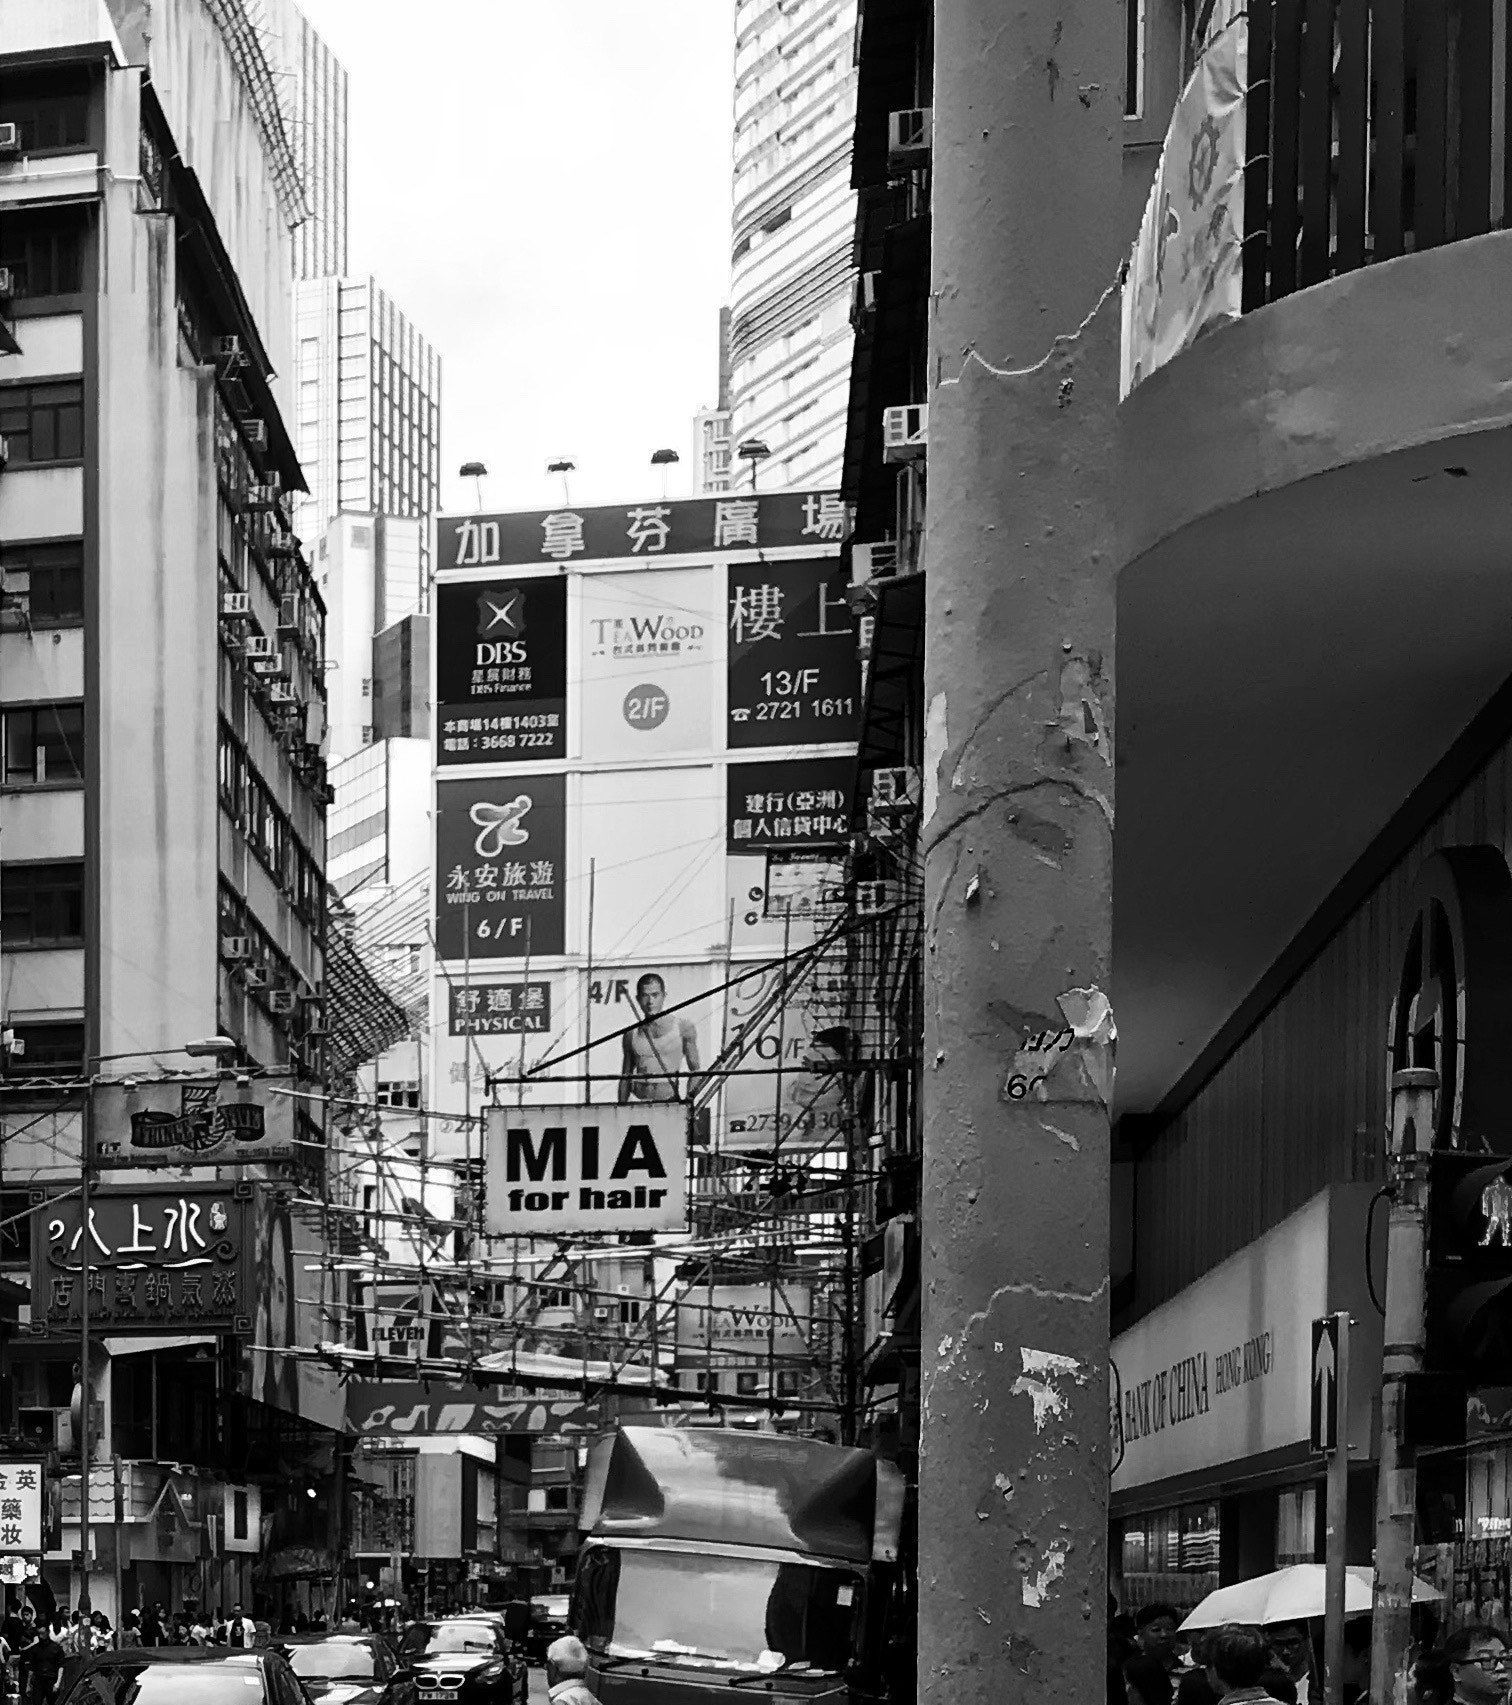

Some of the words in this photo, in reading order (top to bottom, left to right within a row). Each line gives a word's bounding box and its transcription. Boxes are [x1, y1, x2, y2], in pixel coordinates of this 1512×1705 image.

[455, 493, 848, 565] 加拿芬廣場
[730, 582, 854, 645] 樓上
[476, 640, 528, 665] DBS
[760, 668, 820, 696] 13/F
[628, 696, 667, 720] 2/F
[755, 701, 801, 721] 2721
[811, 698, 853, 718] 1611
[519, 732, 554, 747] 7222
[447, 860, 554, 890] 永安旅遊
[477, 917, 523, 939] 6/F
[454, 1015, 546, 1032] PHYSICAL
[506, 1125, 667, 1182] MIA
[508, 1188, 569, 1211] for
[579, 1186, 668, 1210] hair
[1124, 1380, 1152, 1443] BANK
[1152, 1370, 1169, 1433] OF
[1169, 1351, 1210, 1427] CHINA
